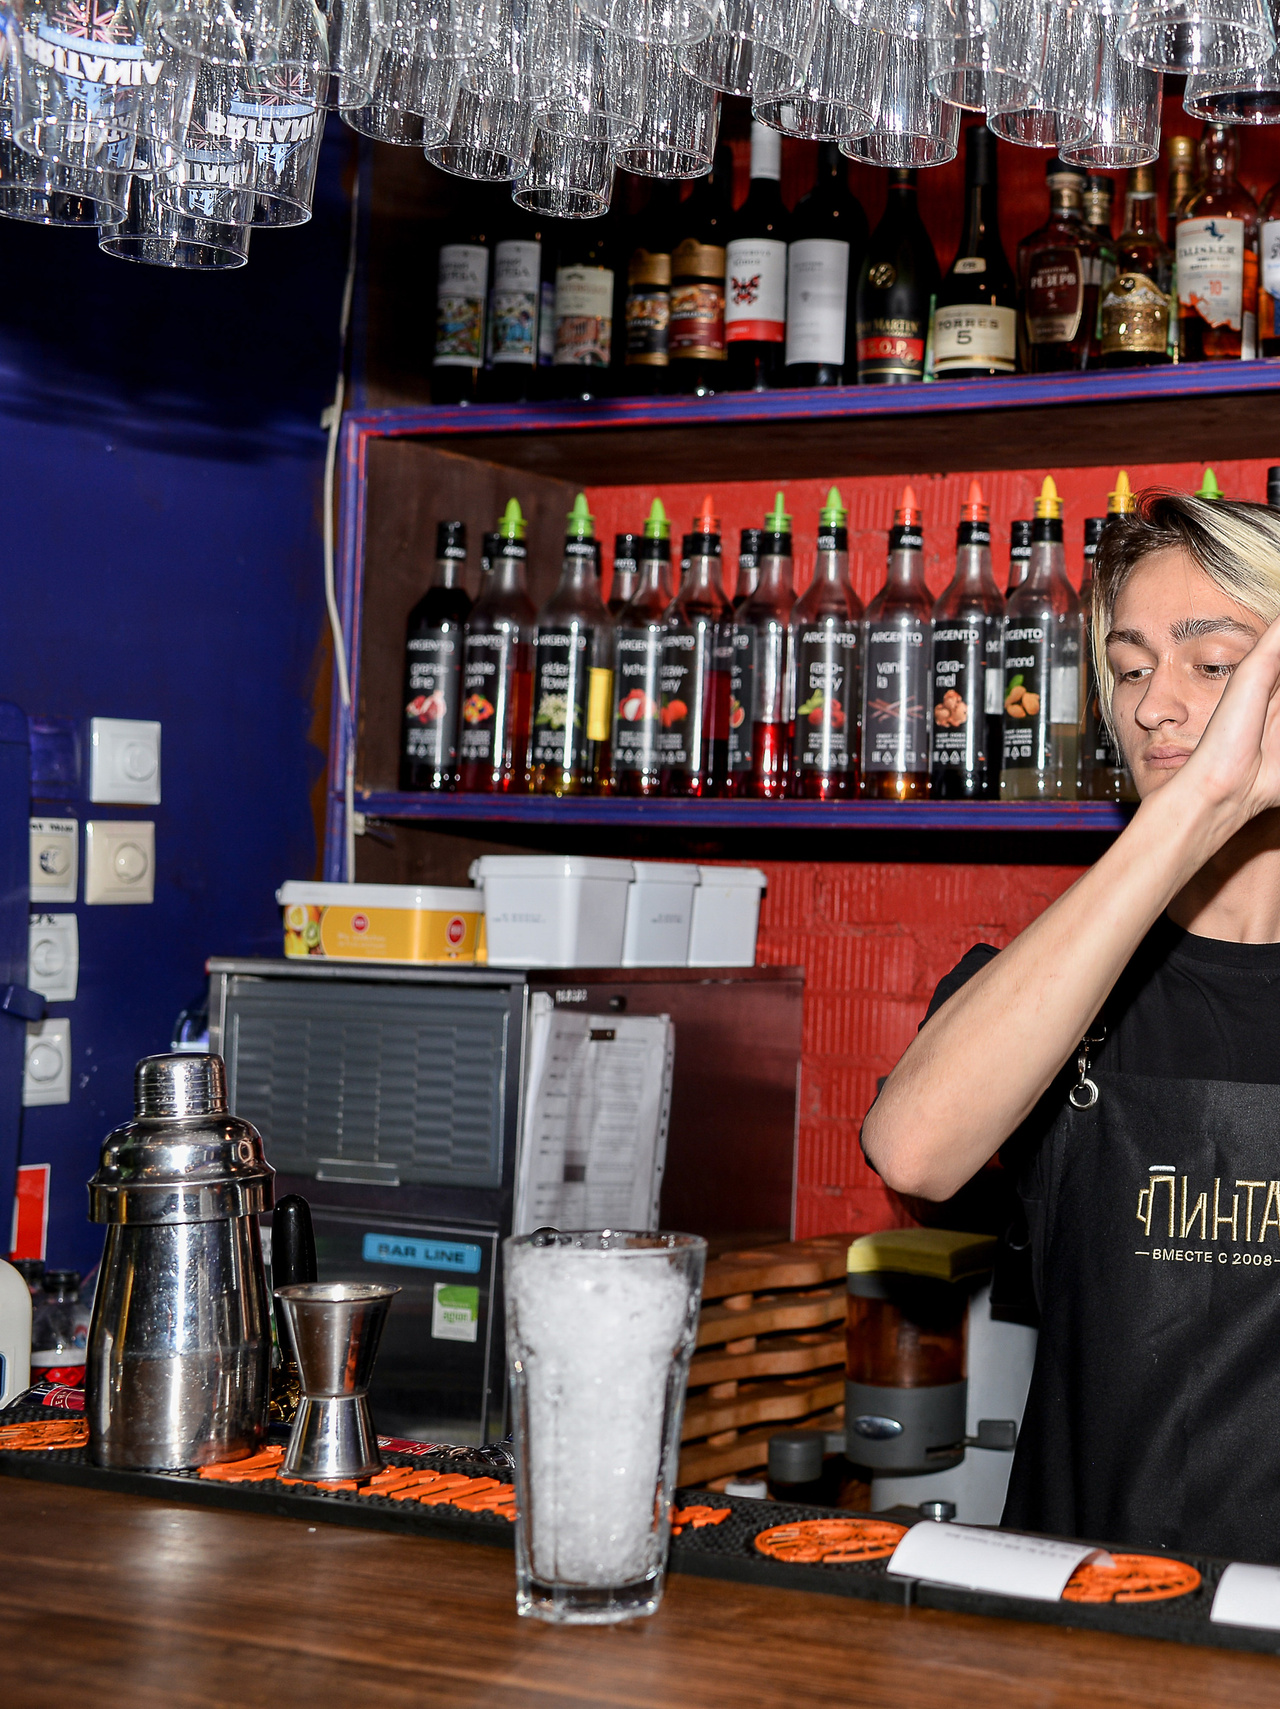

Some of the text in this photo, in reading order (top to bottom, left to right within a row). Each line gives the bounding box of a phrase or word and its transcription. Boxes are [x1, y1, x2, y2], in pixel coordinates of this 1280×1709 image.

[1209, 280, 1223, 296] 10
[937, 318, 999, 330] TORRES
[956, 329, 973, 345] 5
[540, 635, 586, 649] ARGENO
[377, 1243, 466, 1265] BAR LINE
[1152, 1248, 1274, 1267] ВМЕСТЕ С 2008
